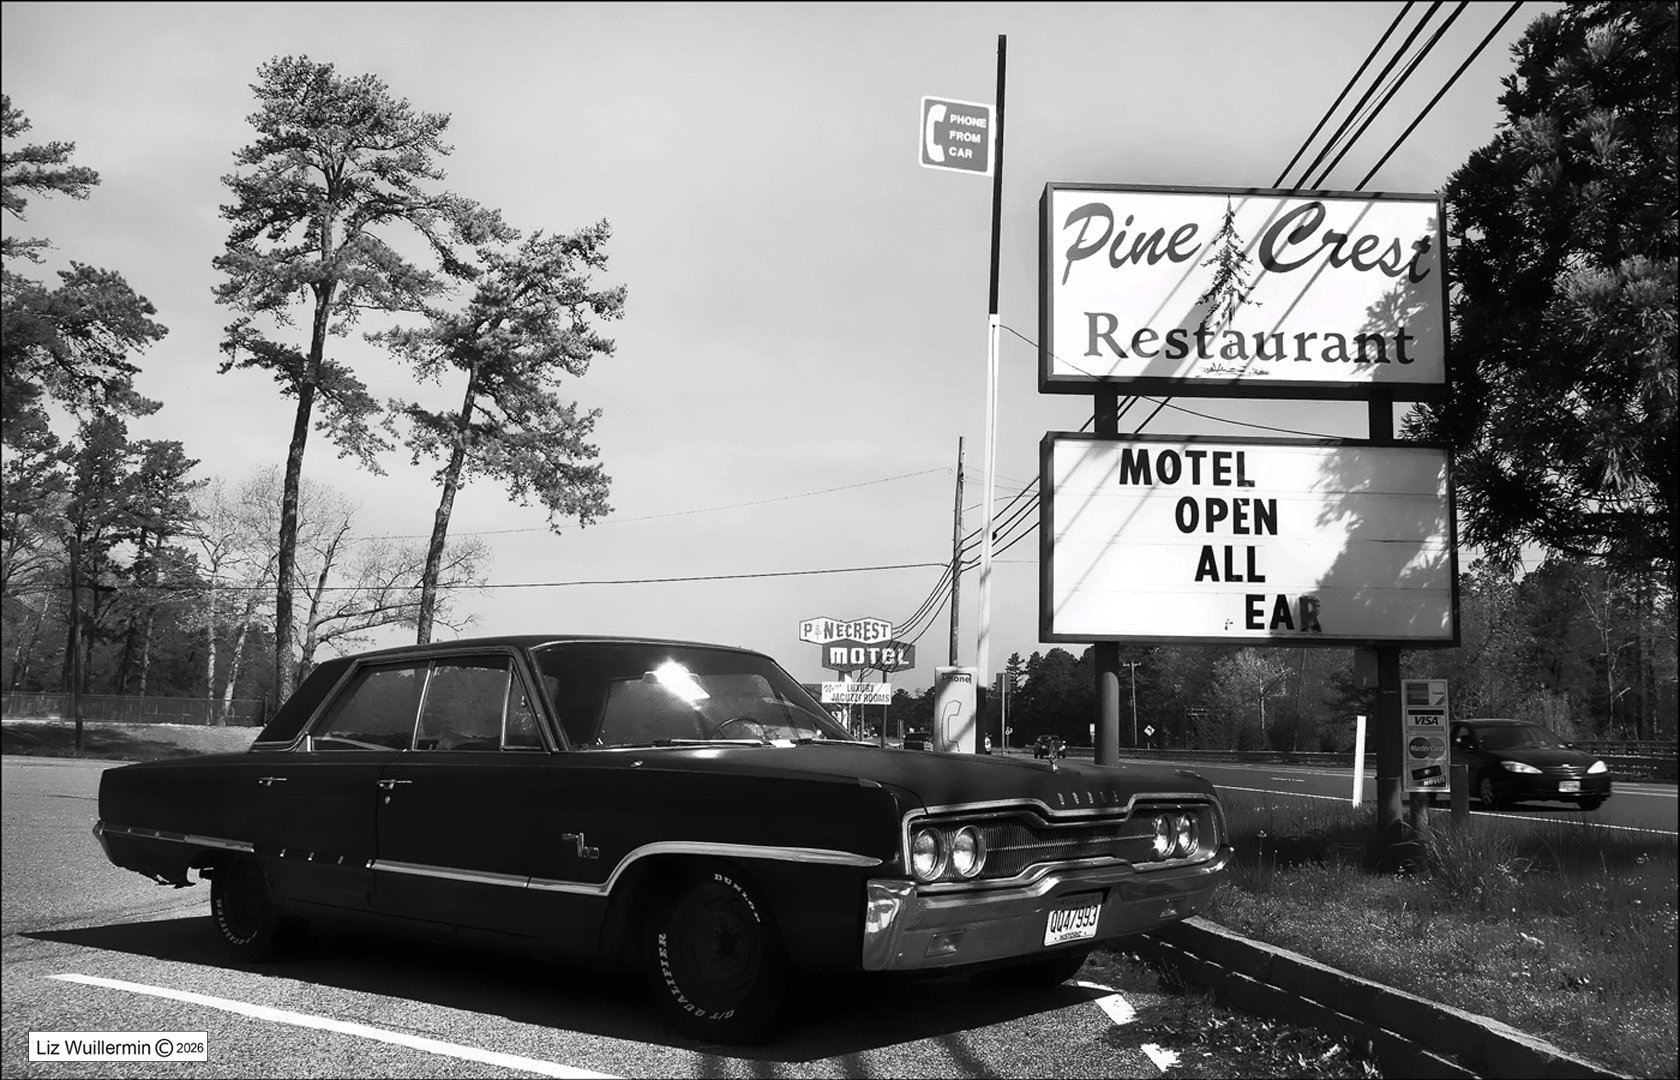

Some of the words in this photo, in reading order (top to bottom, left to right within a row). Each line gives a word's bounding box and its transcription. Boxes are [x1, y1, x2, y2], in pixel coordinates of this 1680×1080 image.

[949, 113, 987, 128] PHONE
[949, 130, 981, 144] FROM
[948, 146, 973, 159] CAR
[1062, 202, 1202, 286] Pine
[1258, 201, 1432, 284] Crest
[1083, 311, 1415, 365] Restaurant
[1119, 448, 1256, 488] MOTEL
[1175, 496, 1278, 536] OPEN
[1194, 545, 1266, 583] ALL
[829, 646, 910, 666] MOTEL
[1414, 715, 1439, 726] VISA
[658, 933, 706, 1017] QUALIFIER
